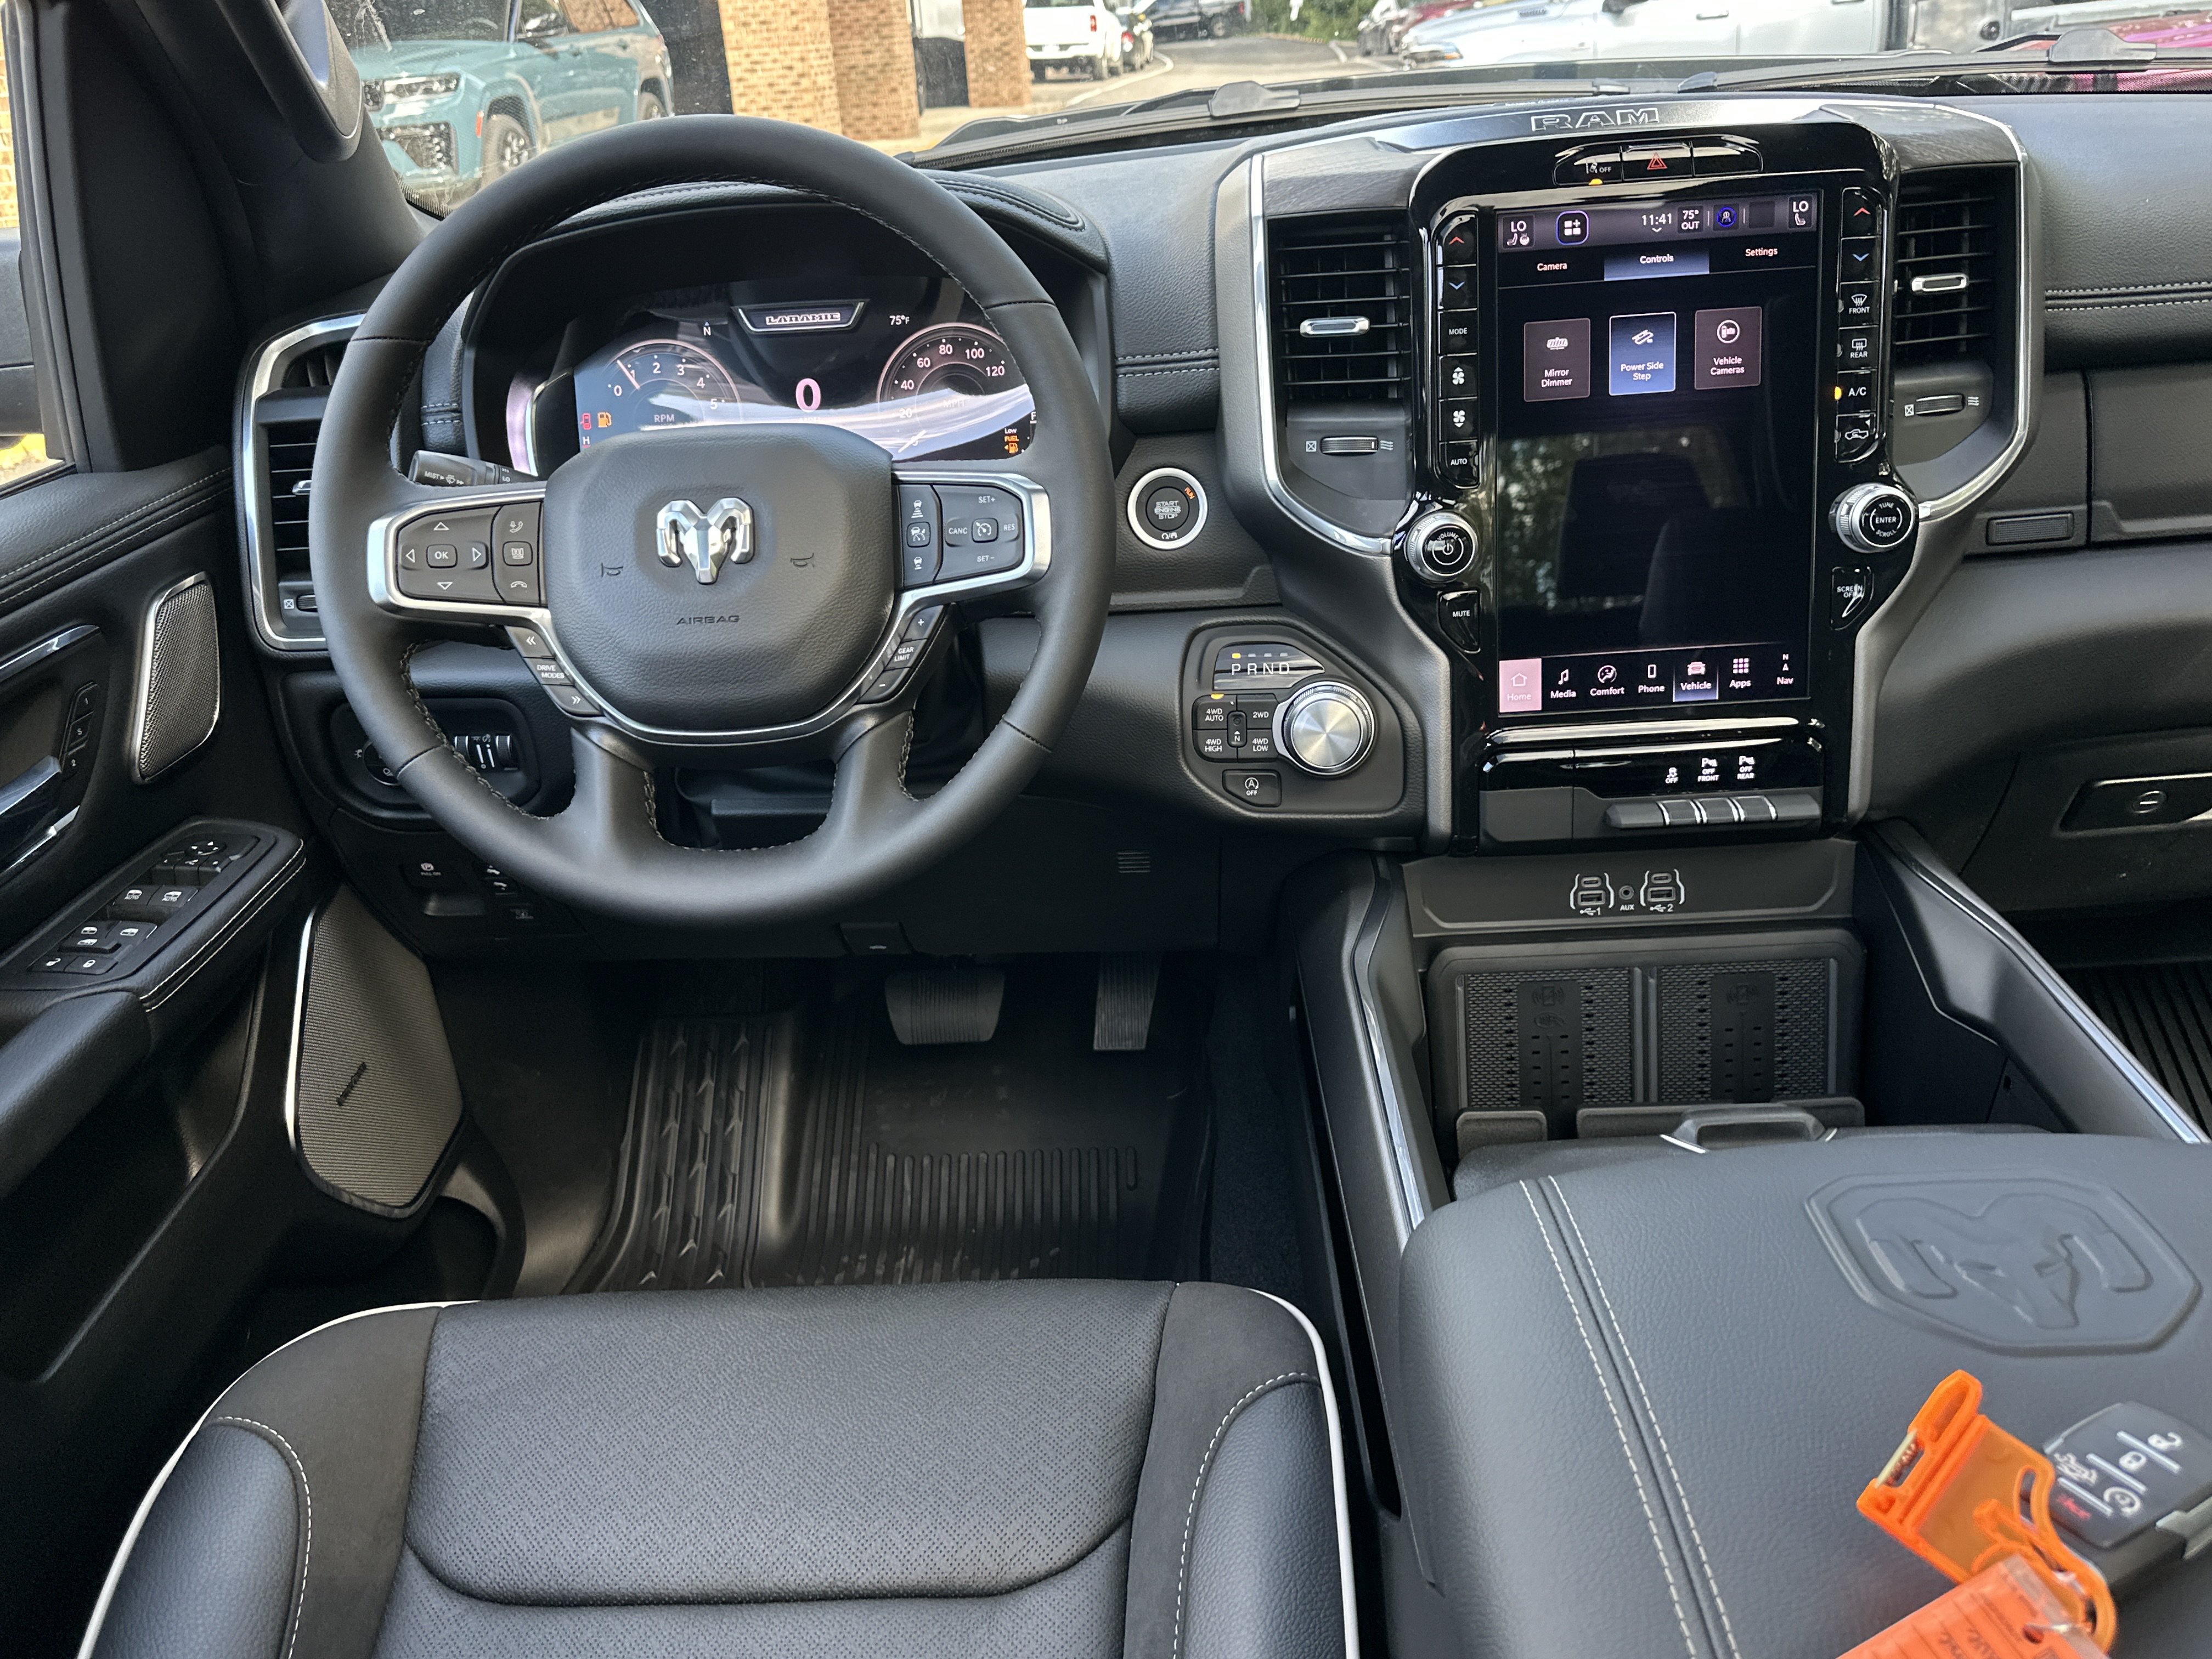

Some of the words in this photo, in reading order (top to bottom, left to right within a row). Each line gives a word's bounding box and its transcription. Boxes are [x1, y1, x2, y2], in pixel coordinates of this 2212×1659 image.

[1531, 108, 1660, 132] RAM
[1793, 200, 1809, 212] LO
[1641, 213, 1672, 227] 11:41
[1511, 221, 1526, 232] LO
[1681, 221, 1700, 230] OUT
[1745, 247, 1778, 257] Settings
[1639, 253, 1674, 264] Controls
[1537, 263, 1567, 272] Camera
[766, 312, 840, 325] LARAMIE
[703, 327, 711, 336] N
[939, 345, 953, 354] 80
[966, 348, 985, 359] 100
[917, 358, 930, 368] 60
[1713, 356, 1742, 365] Vehicle
[652, 362, 661, 374] 2
[677, 364, 685, 376] 3
[986, 366, 1005, 376] 120
[1621, 363, 1645, 372] Power
[1646, 361, 1664, 370] Side
[1710, 366, 1745, 375] Cameras
[1544, 368, 1570, 377] Mirror
[1633, 372, 1651, 381] Step
[696, 377, 706, 388] 4
[901, 380, 915, 390] 40
[1541, 377, 1572, 387] Dimmer
[614, 385, 622, 396] 0
[795, 378, 821, 413] 0
[1848, 386, 1867, 397] A/C
[710, 398, 718, 409] 5
[943, 399, 965, 408] MPH
[654, 414, 675, 422] RPM
[899, 409, 912, 418] 20
[1031, 412, 1036, 421] F
[424, 471, 440, 480] MIST
[1184, 487, 1195, 500] RUN
[1437, 531, 1459, 541] VOLUME
[1876, 529, 1897, 538] SCROLL
[435, 551, 449, 560] OK
[1837, 585, 1863, 593] SCREN
[676, 615, 740, 625] AIRBAG
[894, 653, 910, 662] LIMIT
[1231, 663, 1242, 675] P
[1247, 663, 1257, 675] R
[1263, 663, 1274, 675] N
[1279, 663, 1290, 674] D
[1729, 679, 1752, 689] Apps
[1776, 676, 1794, 685] Nav
[1590, 686, 1625, 696] Comfort
[1638, 684, 1665, 693] Phone
[1680, 681, 1712, 691] Vehicle
[1507, 693, 1532, 701] Home
[1550, 690, 1576, 698] Media
[1597, 907, 1601, 916] 1
[1667, 904, 1673, 912] 2
